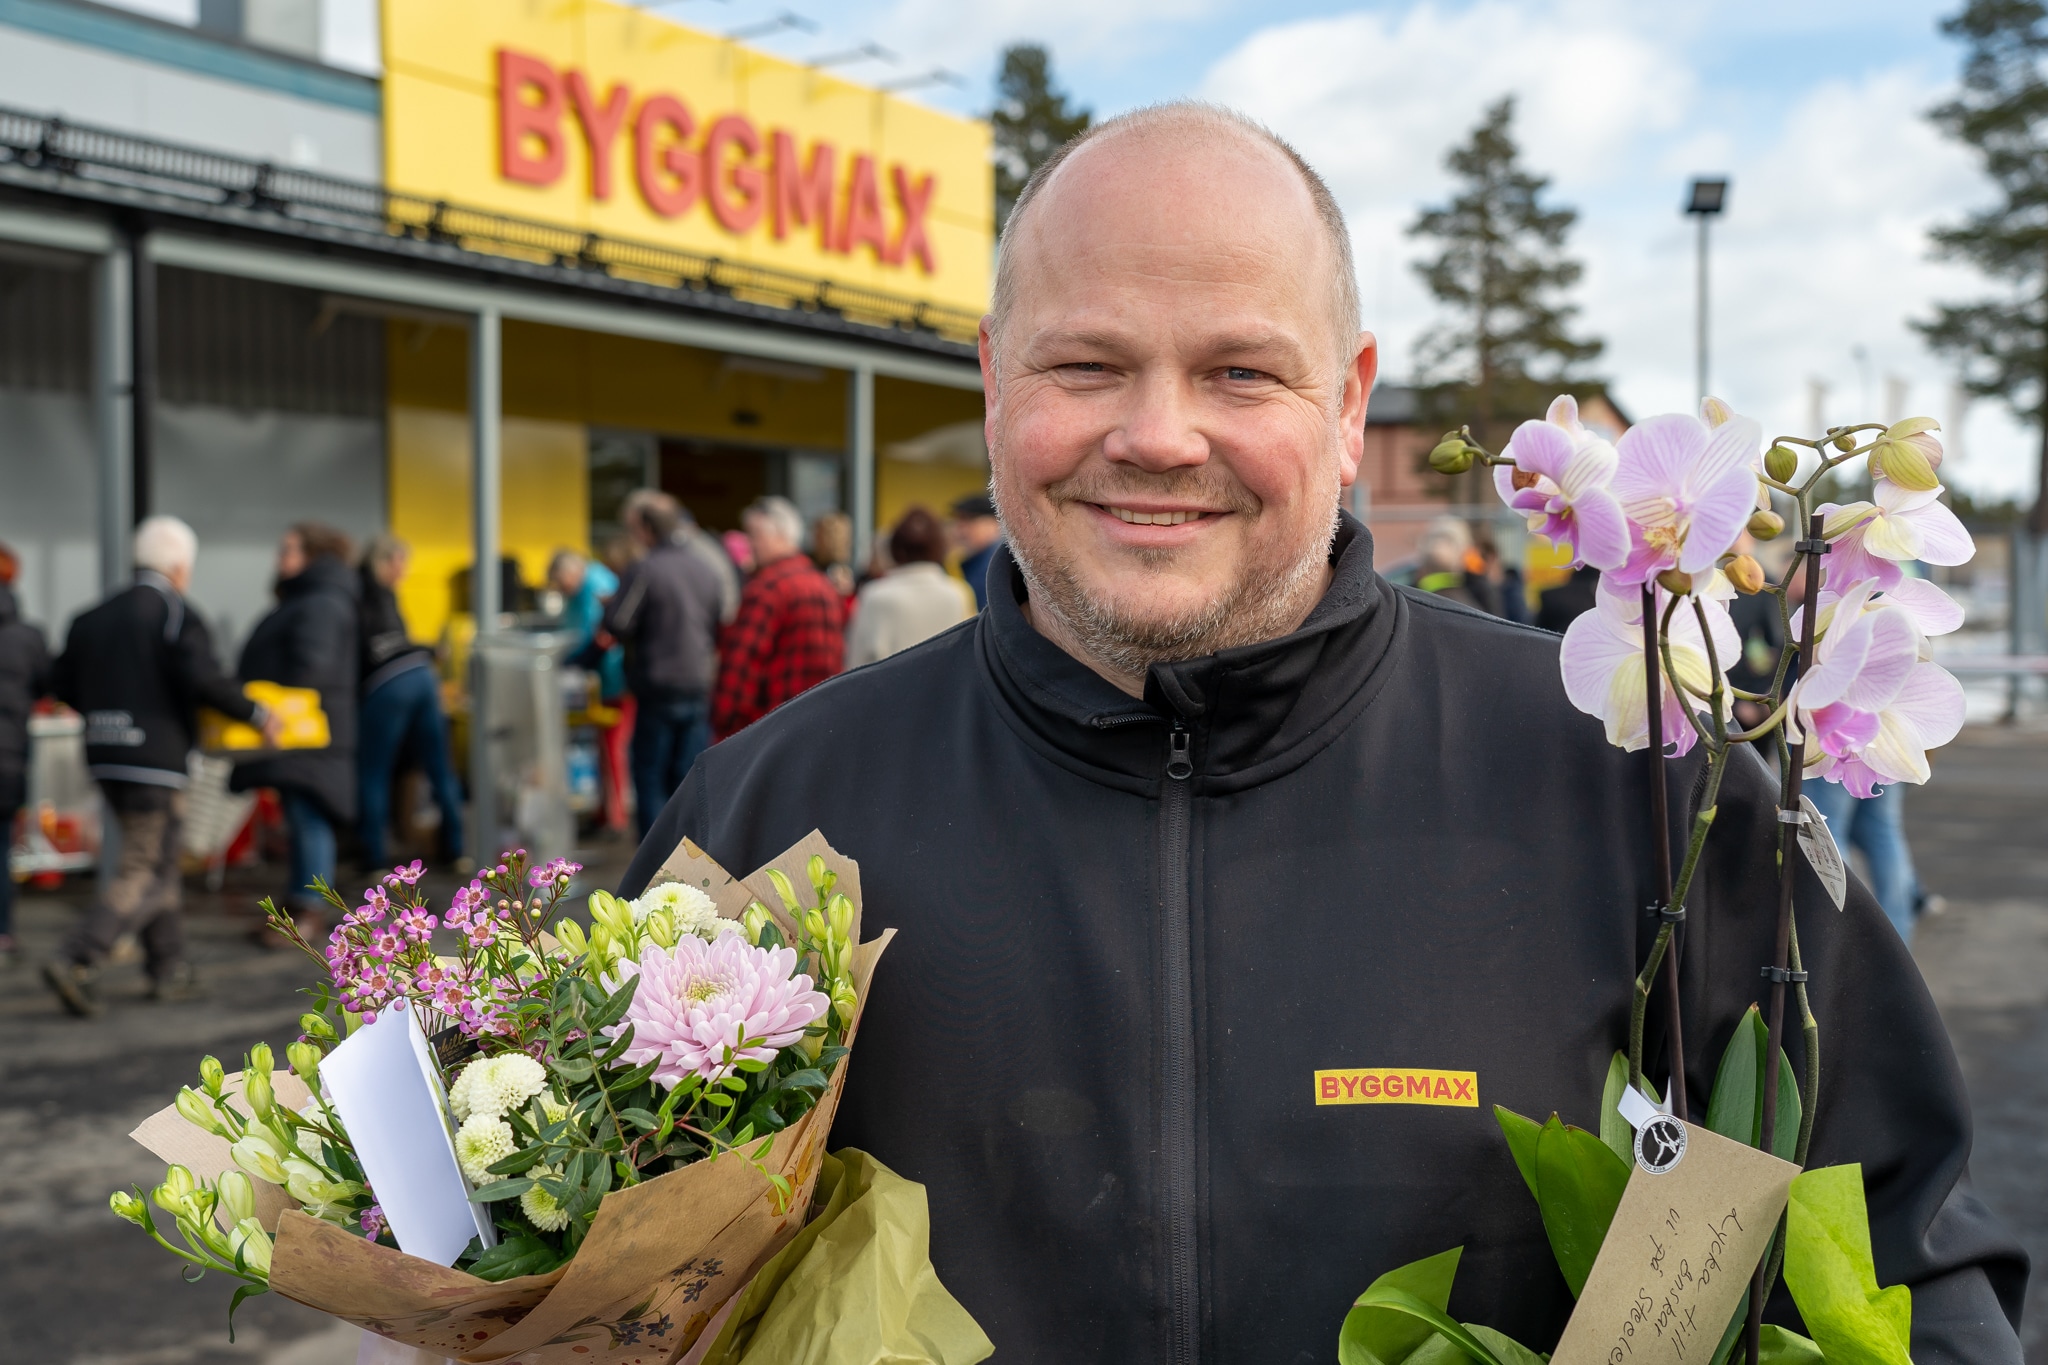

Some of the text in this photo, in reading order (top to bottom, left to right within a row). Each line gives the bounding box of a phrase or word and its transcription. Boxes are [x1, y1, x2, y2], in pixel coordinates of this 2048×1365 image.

[495, 47, 935, 274] BYGGMAX
[1321, 1075, 1472, 1101] BYGGMAX
[1649, 1234, 1666, 1278] på
[1671, 1207, 1743, 1361] Lycka till
